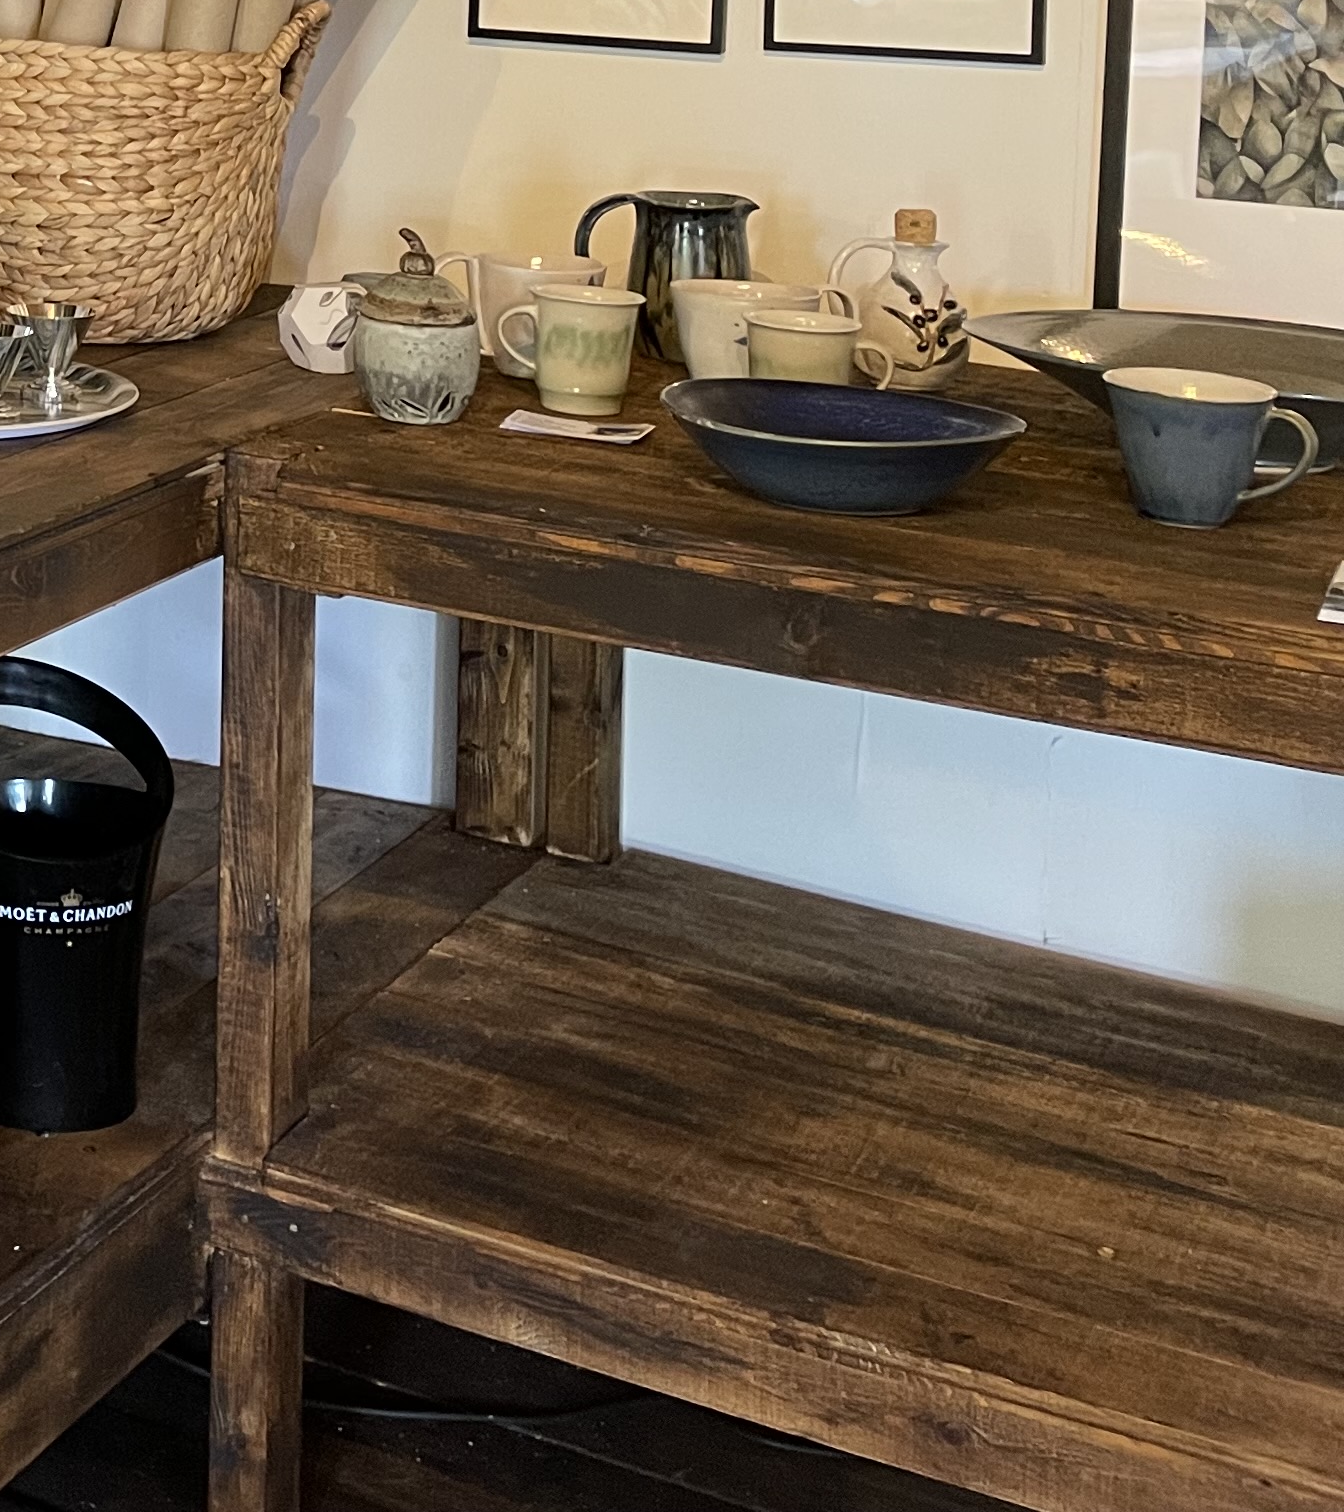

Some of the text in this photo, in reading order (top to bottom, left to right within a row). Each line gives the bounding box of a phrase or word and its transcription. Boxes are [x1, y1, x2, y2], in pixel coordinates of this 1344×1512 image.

[0, 905, 47, 922] MOËT
[49, 912, 60, 923] &
[63, 899, 134, 923] CHANDON
[24, 925, 109, 935] CHAMPAGNE
